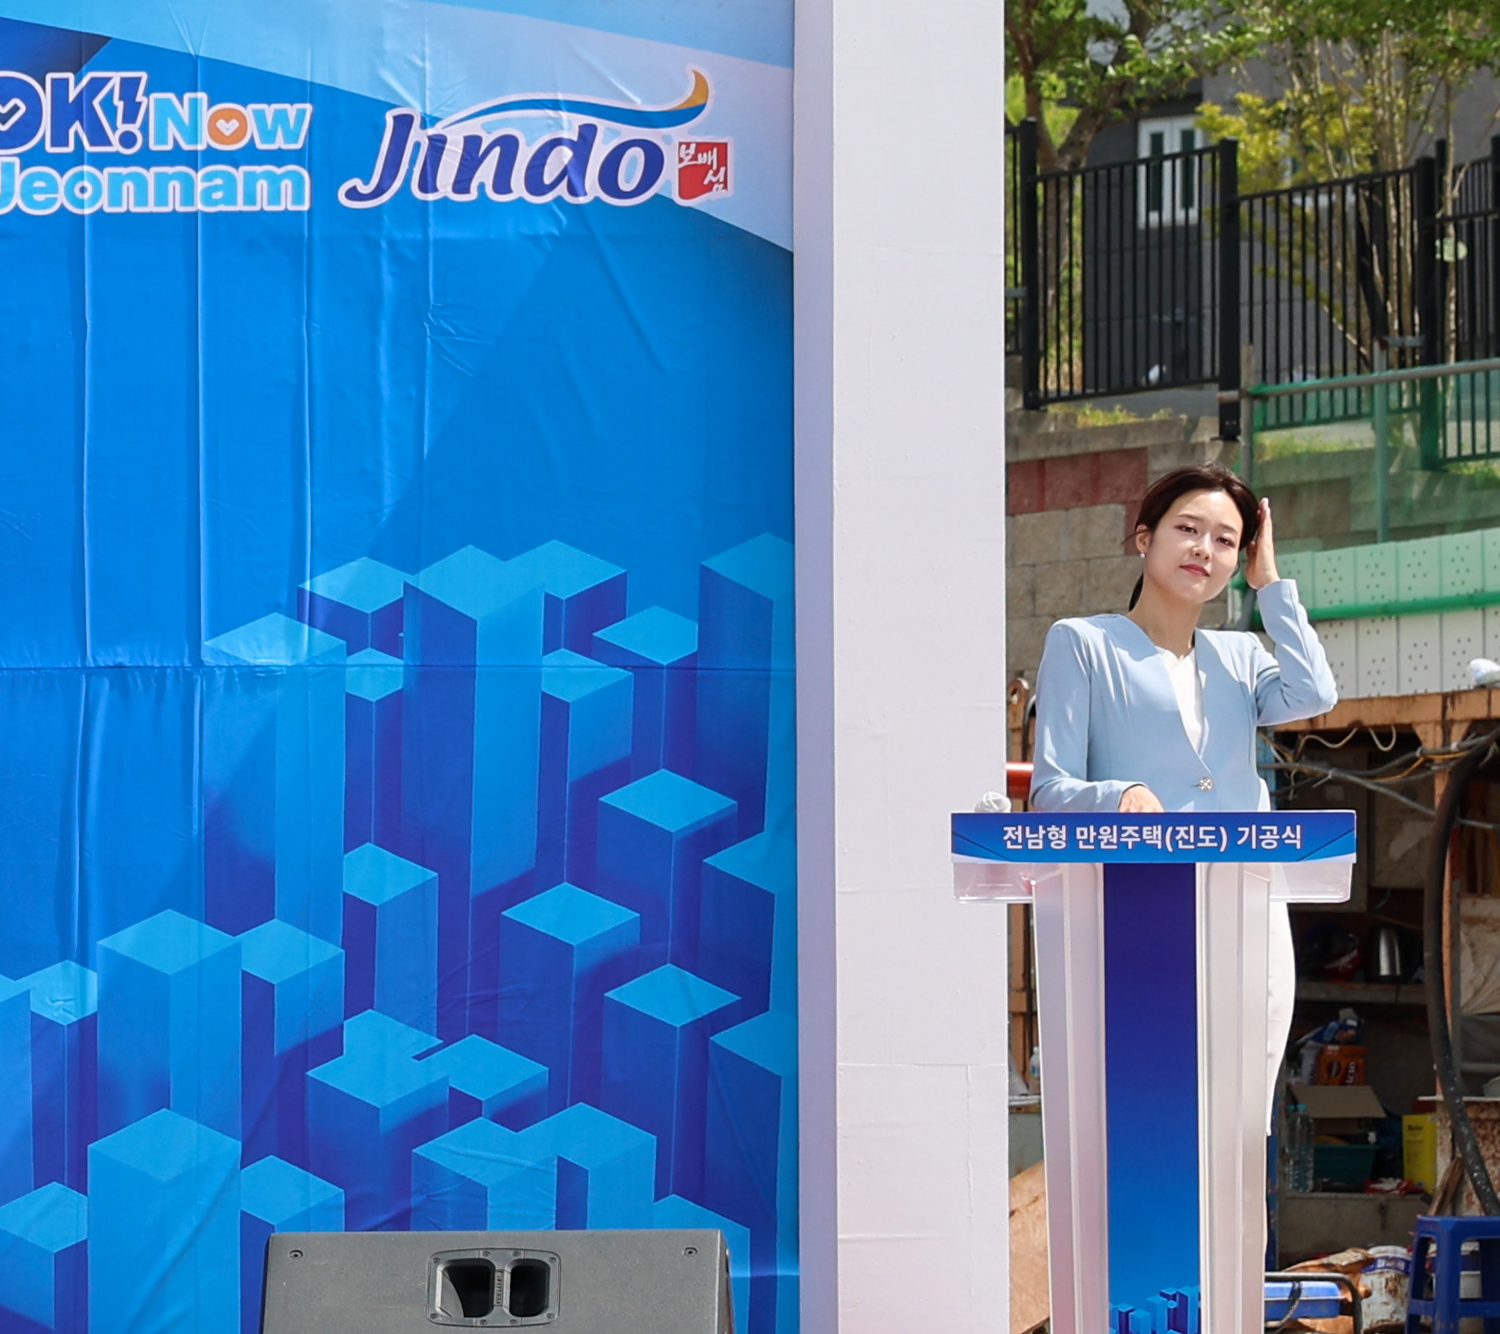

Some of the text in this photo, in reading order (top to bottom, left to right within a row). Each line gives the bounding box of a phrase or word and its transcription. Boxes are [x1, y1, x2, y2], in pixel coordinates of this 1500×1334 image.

[338, 105, 666, 208] Jindo
[1002, 824, 1302, 853] 전남형 만원주택(진도) 기공식
